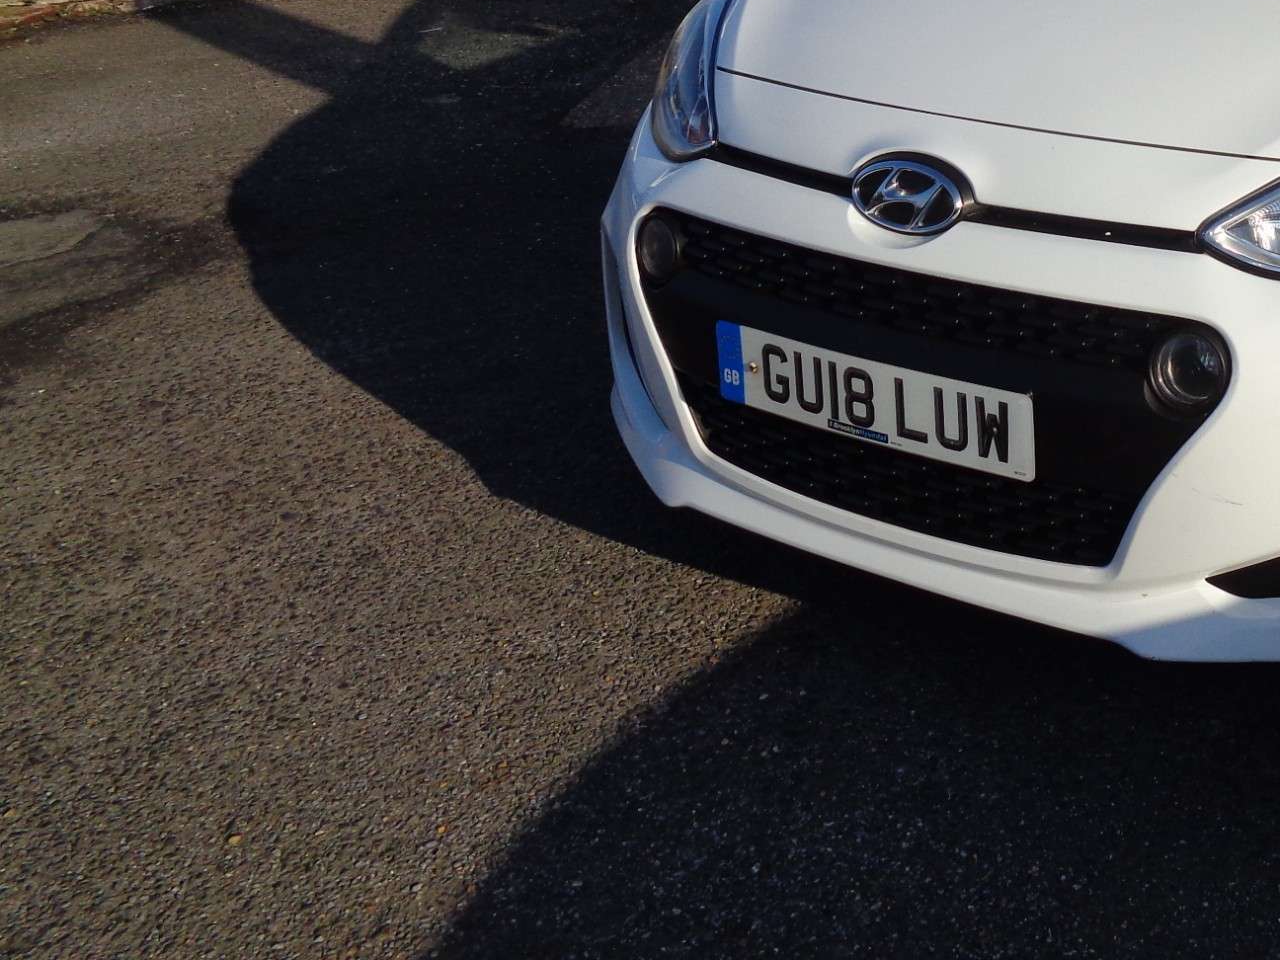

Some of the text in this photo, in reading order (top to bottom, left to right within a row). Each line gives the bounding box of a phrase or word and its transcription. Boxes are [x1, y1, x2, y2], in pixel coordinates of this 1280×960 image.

[723, 367, 740, 386] GB
[761, 343, 1009, 464] GU18 LUW
